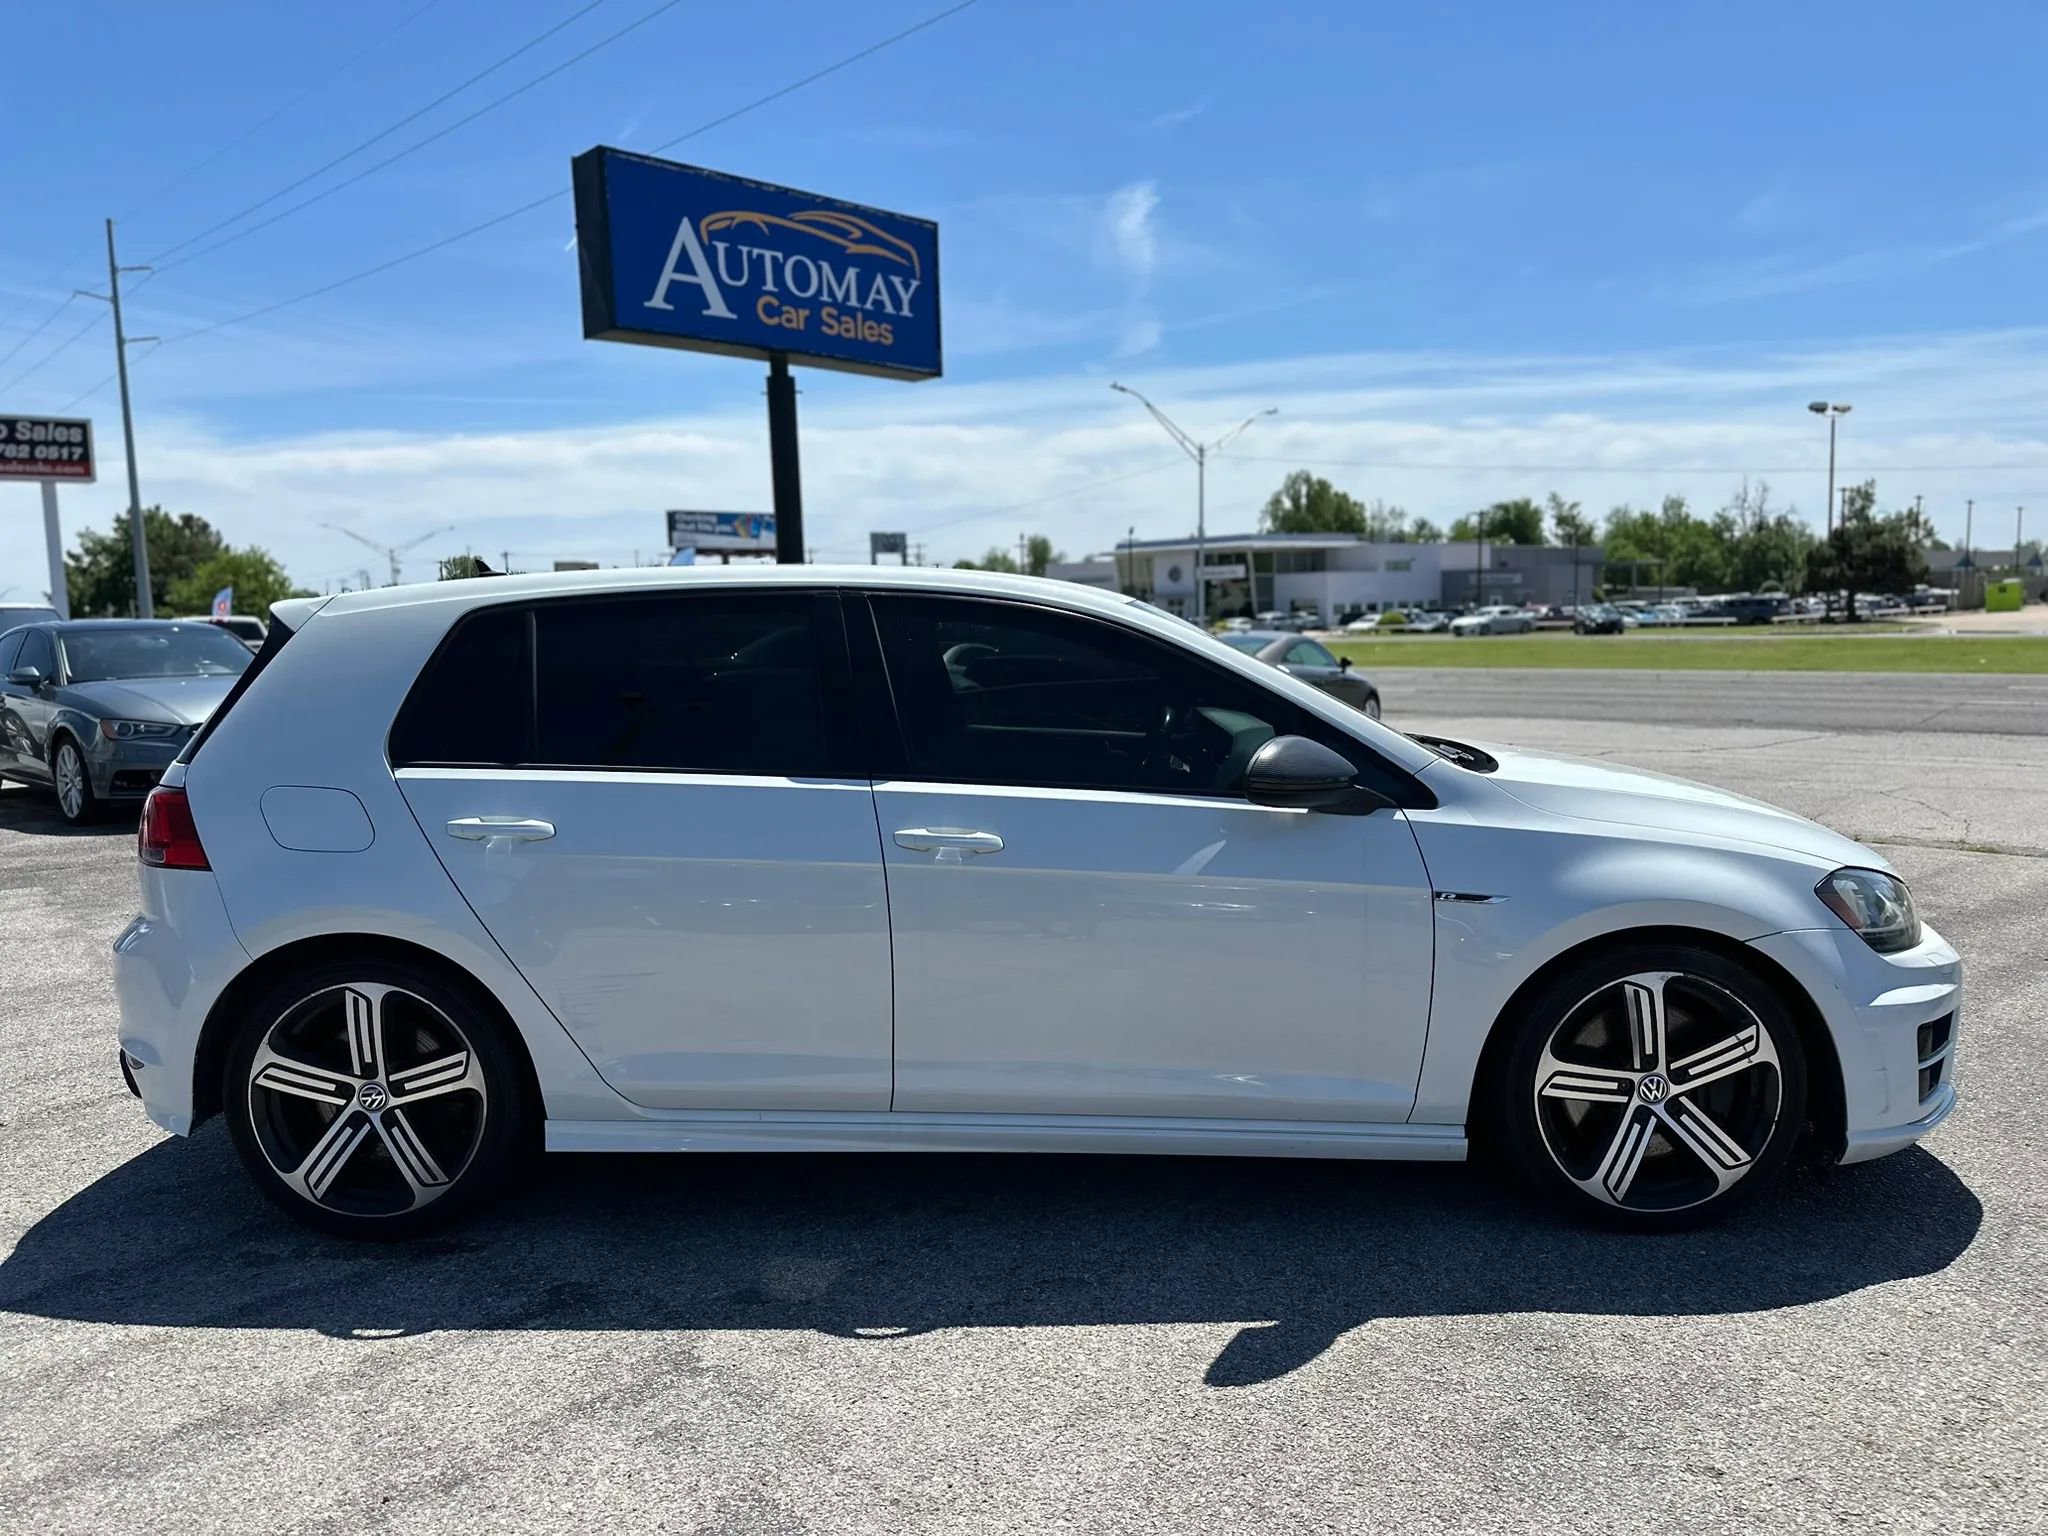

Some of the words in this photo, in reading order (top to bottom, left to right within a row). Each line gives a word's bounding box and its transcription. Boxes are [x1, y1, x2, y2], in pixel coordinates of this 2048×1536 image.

[643, 216, 921, 319] AUTOMAY
[757, 295, 810, 331] Car
[821, 306, 893, 346] Sales
[15, 420, 83, 443] Sales
[34, 444, 84, 461] 0517
